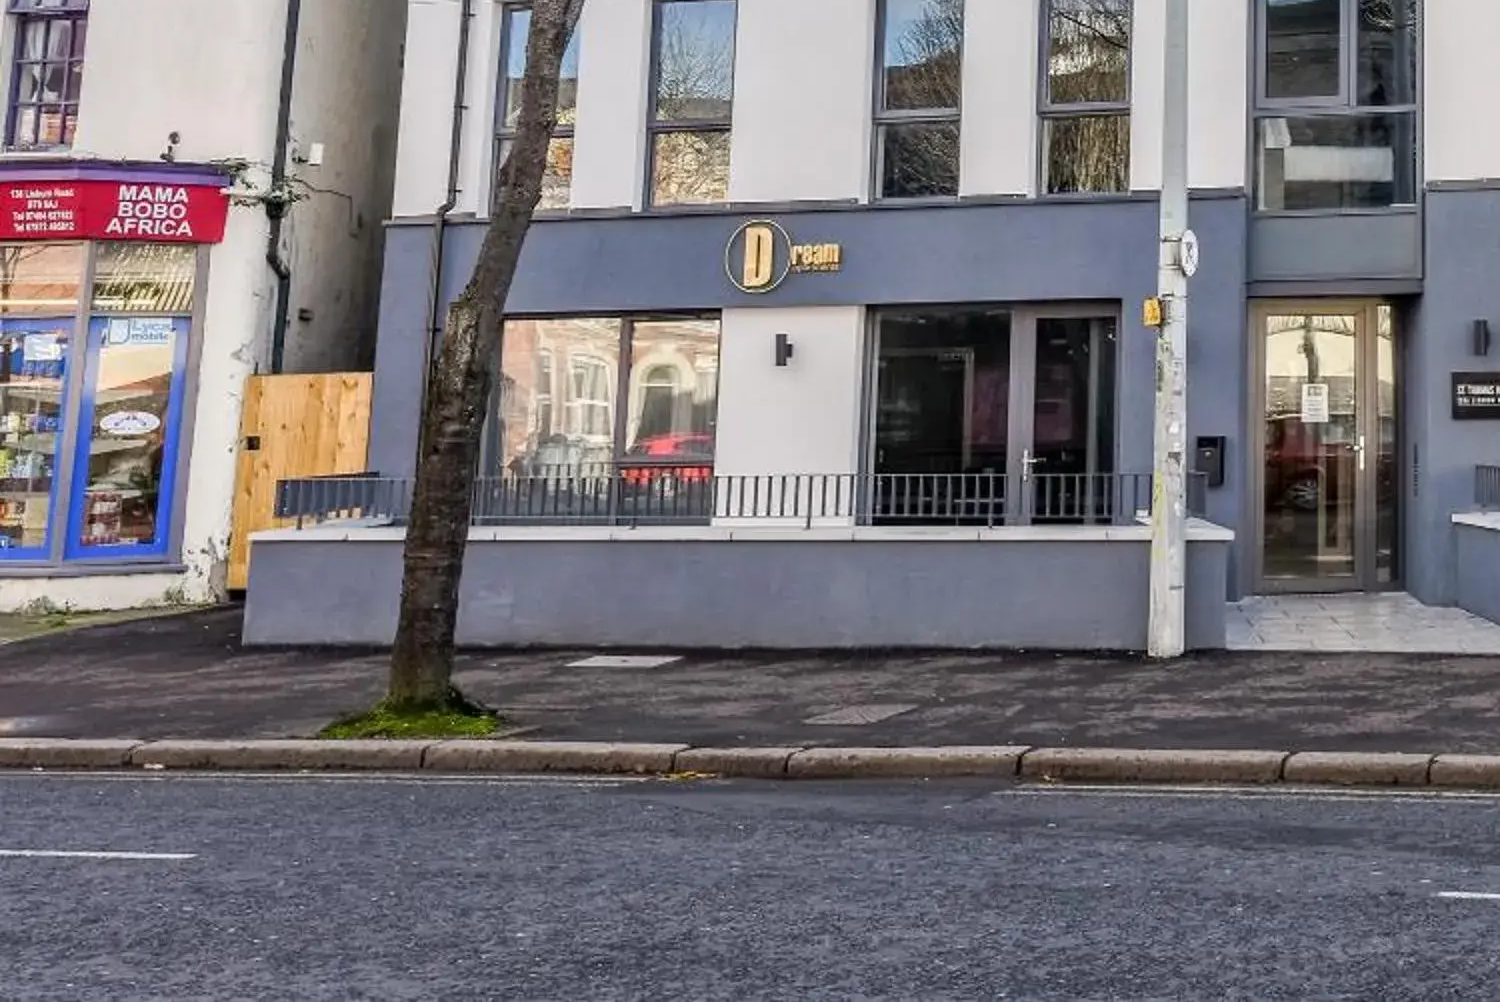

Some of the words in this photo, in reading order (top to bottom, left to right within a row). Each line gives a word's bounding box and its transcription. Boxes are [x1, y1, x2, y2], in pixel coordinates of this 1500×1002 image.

[118, 185, 189, 203] MAMA
[117, 201, 188, 219] BOBO
[104, 218, 194, 237] AFRICA
